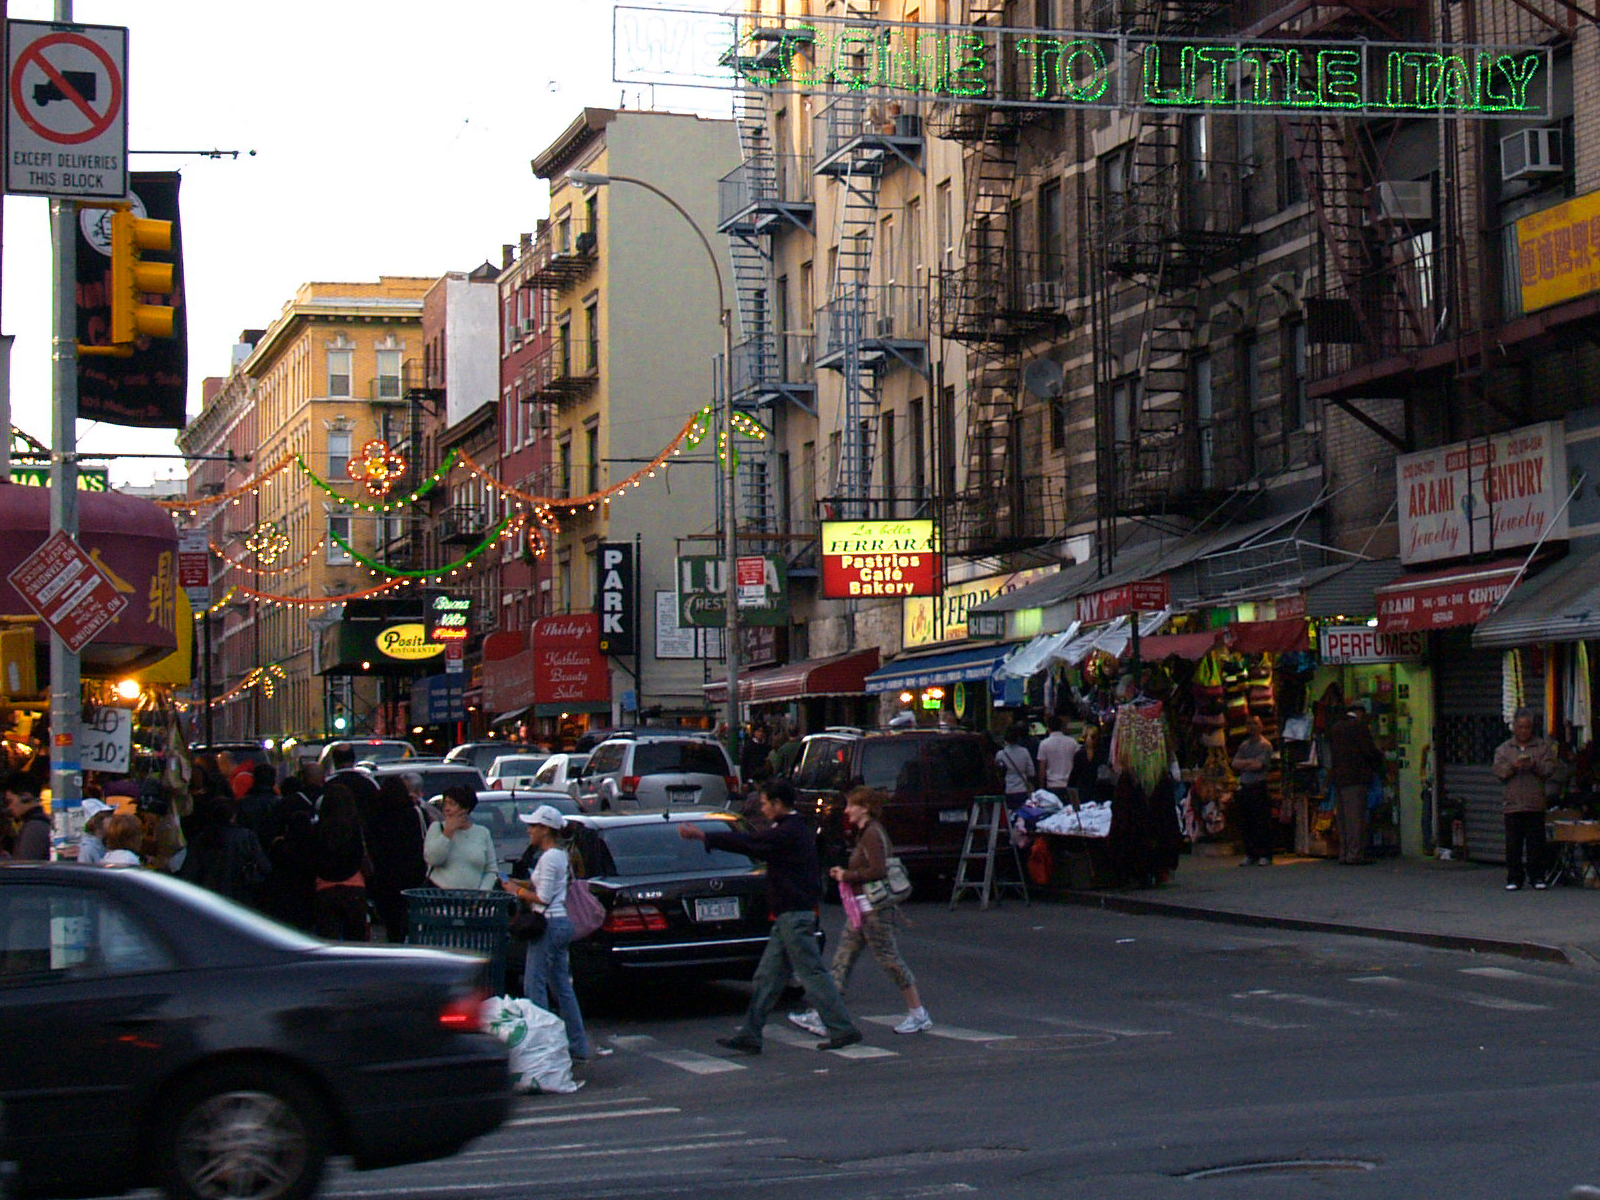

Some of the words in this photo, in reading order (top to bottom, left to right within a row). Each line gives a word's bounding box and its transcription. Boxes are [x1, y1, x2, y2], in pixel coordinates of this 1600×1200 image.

[1016, 39, 1108, 102] TO
[1143, 45, 1362, 107] LITTLE
[1387, 51, 1540, 110] ITALY
[13, 151, 52, 167] EXCEPT
[58, 153, 118, 170] DELIVERIES
[29, 171, 56, 186] THIS
[62, 173, 104, 188] BLOCK
[1483, 457, 1544, 504] CENTURY
[1409, 476, 1454, 518] ARAMI
[1492, 502, 1545, 539] Jewelry
[852, 524, 872, 536] La
[880, 524, 911, 535] bella
[1408, 518, 1459, 557] Jewelry
[62, 546, 77, 562] NO
[830, 538, 933, 552] FERRARA
[841, 553, 920, 569] Pastries
[25, 558, 64, 596] STANDING
[682, 560, 780, 594] LUA
[859, 565, 903, 582] Café
[603, 549, 625, 633] PARK
[849, 580, 914, 595] Bakery
[105, 596, 121, 612] NO
[1078, 594, 1101, 623] NY
[1380, 596, 1415, 614] ARAMI
[68, 609, 108, 647] STANDING
[541, 622, 592, 639] Shirley's
[1328, 631, 1421, 657] PERFUMES
[544, 650, 591, 666] Kathleen
[549, 668, 587, 684] Beauty
[553, 683, 583, 699] Salon
